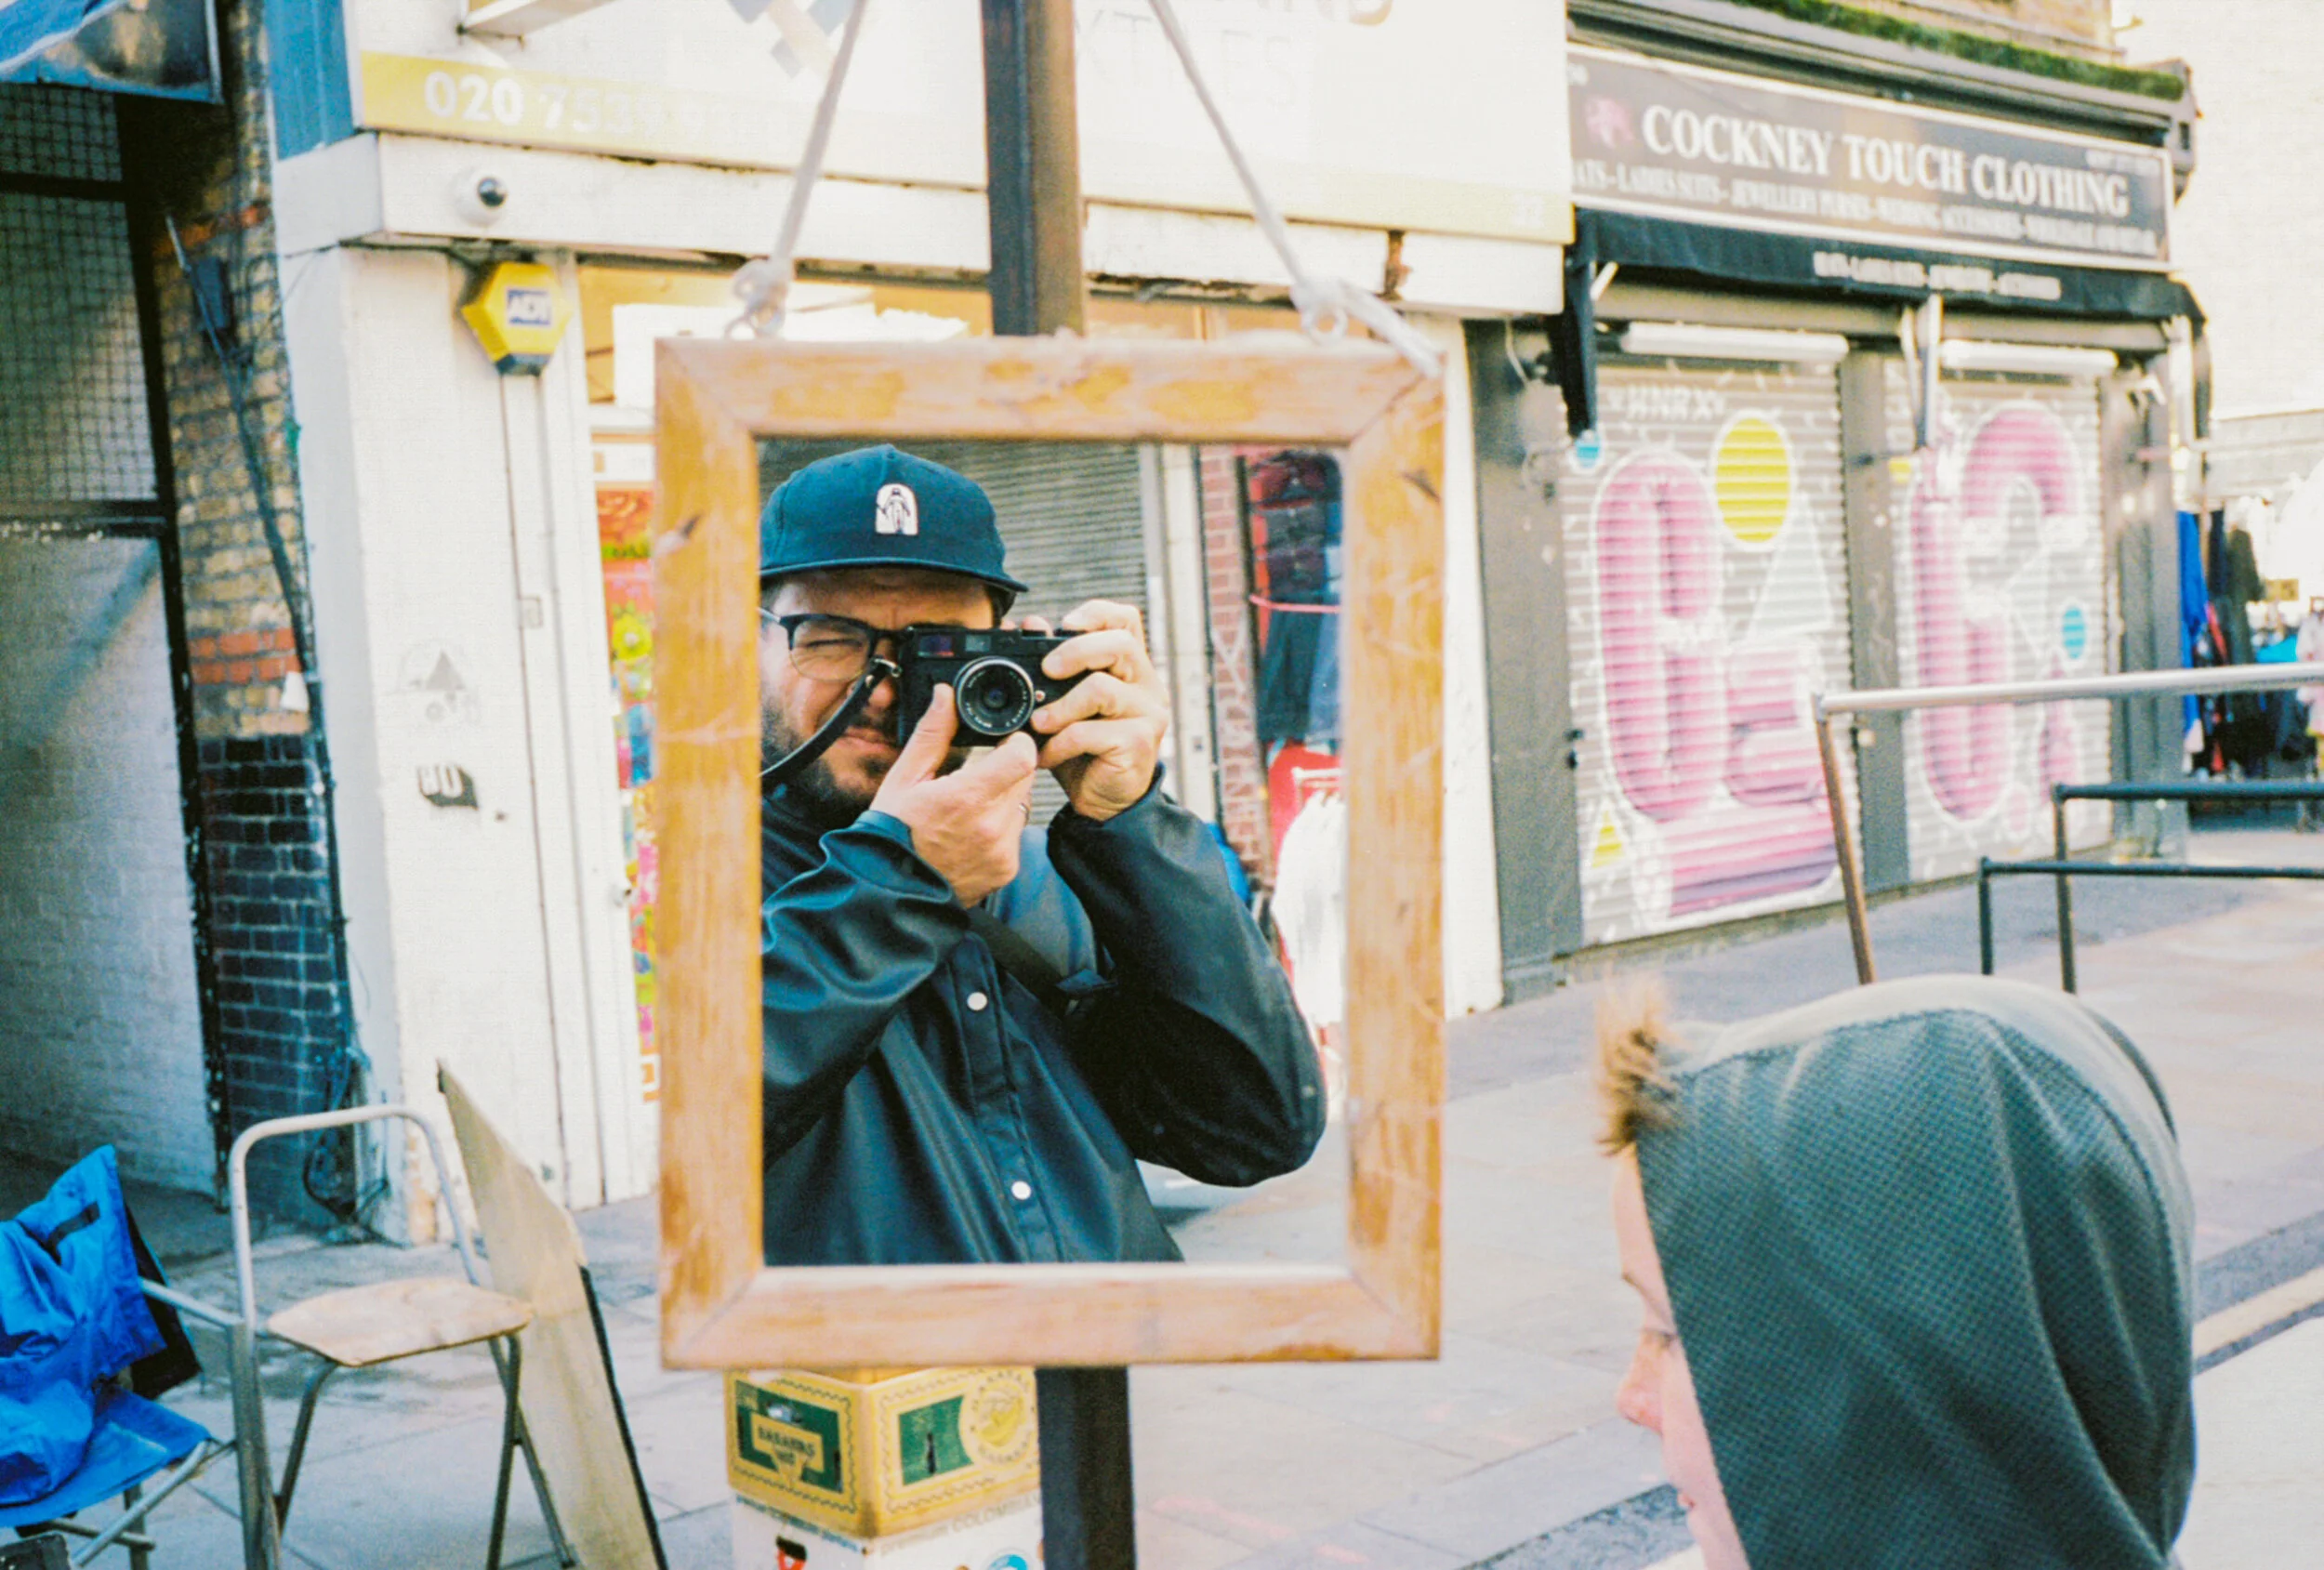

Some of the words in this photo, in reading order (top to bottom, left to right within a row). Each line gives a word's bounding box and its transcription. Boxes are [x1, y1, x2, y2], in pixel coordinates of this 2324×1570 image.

[424, 71, 525, 126] 020
[1641, 104, 1832, 177] COCKNEY
[1842, 133, 1964, 196] TOUCH
[1973, 154, 2130, 218] CLOTHING
